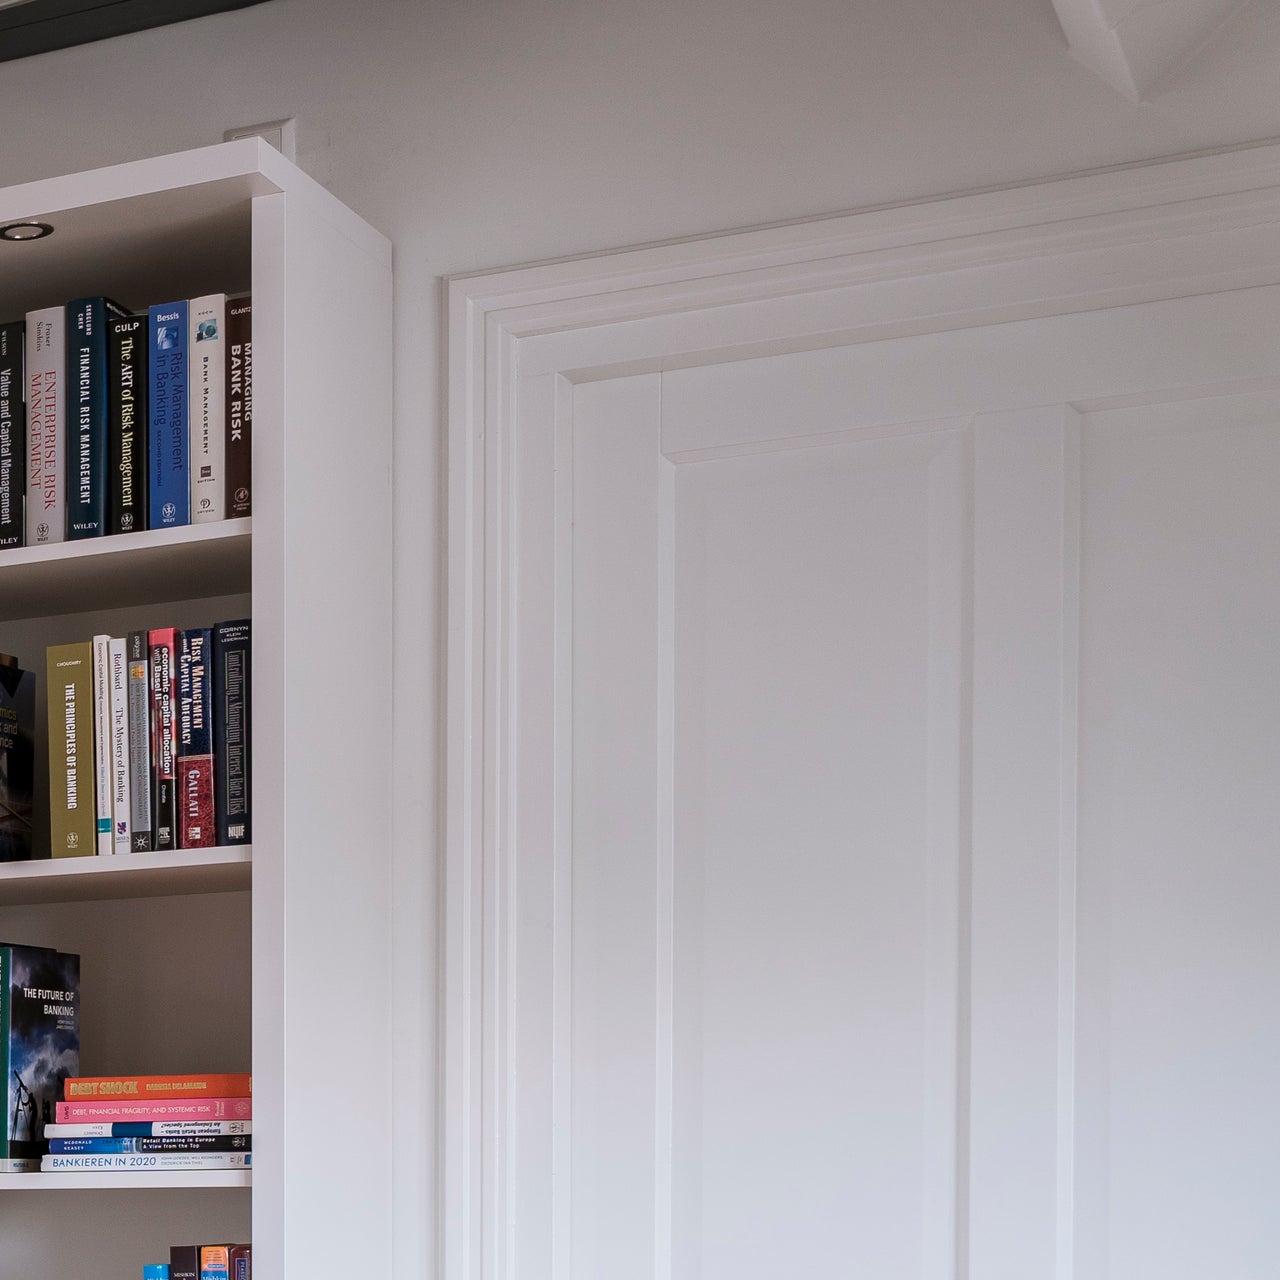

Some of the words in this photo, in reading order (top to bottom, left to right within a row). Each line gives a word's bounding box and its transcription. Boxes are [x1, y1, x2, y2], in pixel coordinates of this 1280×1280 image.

[115, 323, 139, 332] CULP
[157, 314, 180, 322] Bessis
[121, 338, 133, 360] The
[156, 354, 168, 367] in
[170, 353, 182, 379] Risk
[1, 369, 12, 397] Value
[80, 347, 90, 402] FINANCIAL
[121, 364, 132, 387] ART
[231, 345, 241, 394] BANK
[244, 343, 252, 421] MANAGING
[1, 400, 11, 418] and
[121, 389, 133, 400] of
[154, 373, 168, 425] Banking
[31, 374, 41, 489] MANAGEMENT
[45, 371, 56, 470] ENTERPRISE
[80, 407, 90, 430] RISK
[122, 404, 133, 429] Risk
[172, 384, 184, 471] Management
[231, 401, 241, 441] RISK
[0, 421, 12, 456] Capital
[80, 434, 90, 504] MANAGEMENT
[120, 432, 133, 506] Management
[0, 460, 12, 524] Management
[45, 474, 56, 510] RISK
[191, 638, 203, 662] RISK
[162, 648, 170, 692] economic
[180, 655, 191, 692] CAPITAL
[65, 683, 74, 700] THE
[192, 666, 204, 729] MANAGEMENT
[66, 702, 75, 754] PRINCIPLES
[162, 695, 171, 726] capital
[181, 697, 192, 744] ADEQUACY
[66, 756, 76, 767] OF
[163, 728, 171, 773] allocation
[67, 769, 77, 809] BANKING
[188, 770, 200, 817] GALLATI
[53, 1158, 112, 1167] BANKIEREN
[115, 1158, 126, 1166] IN
[130, 1157, 156, 1165] 2020
